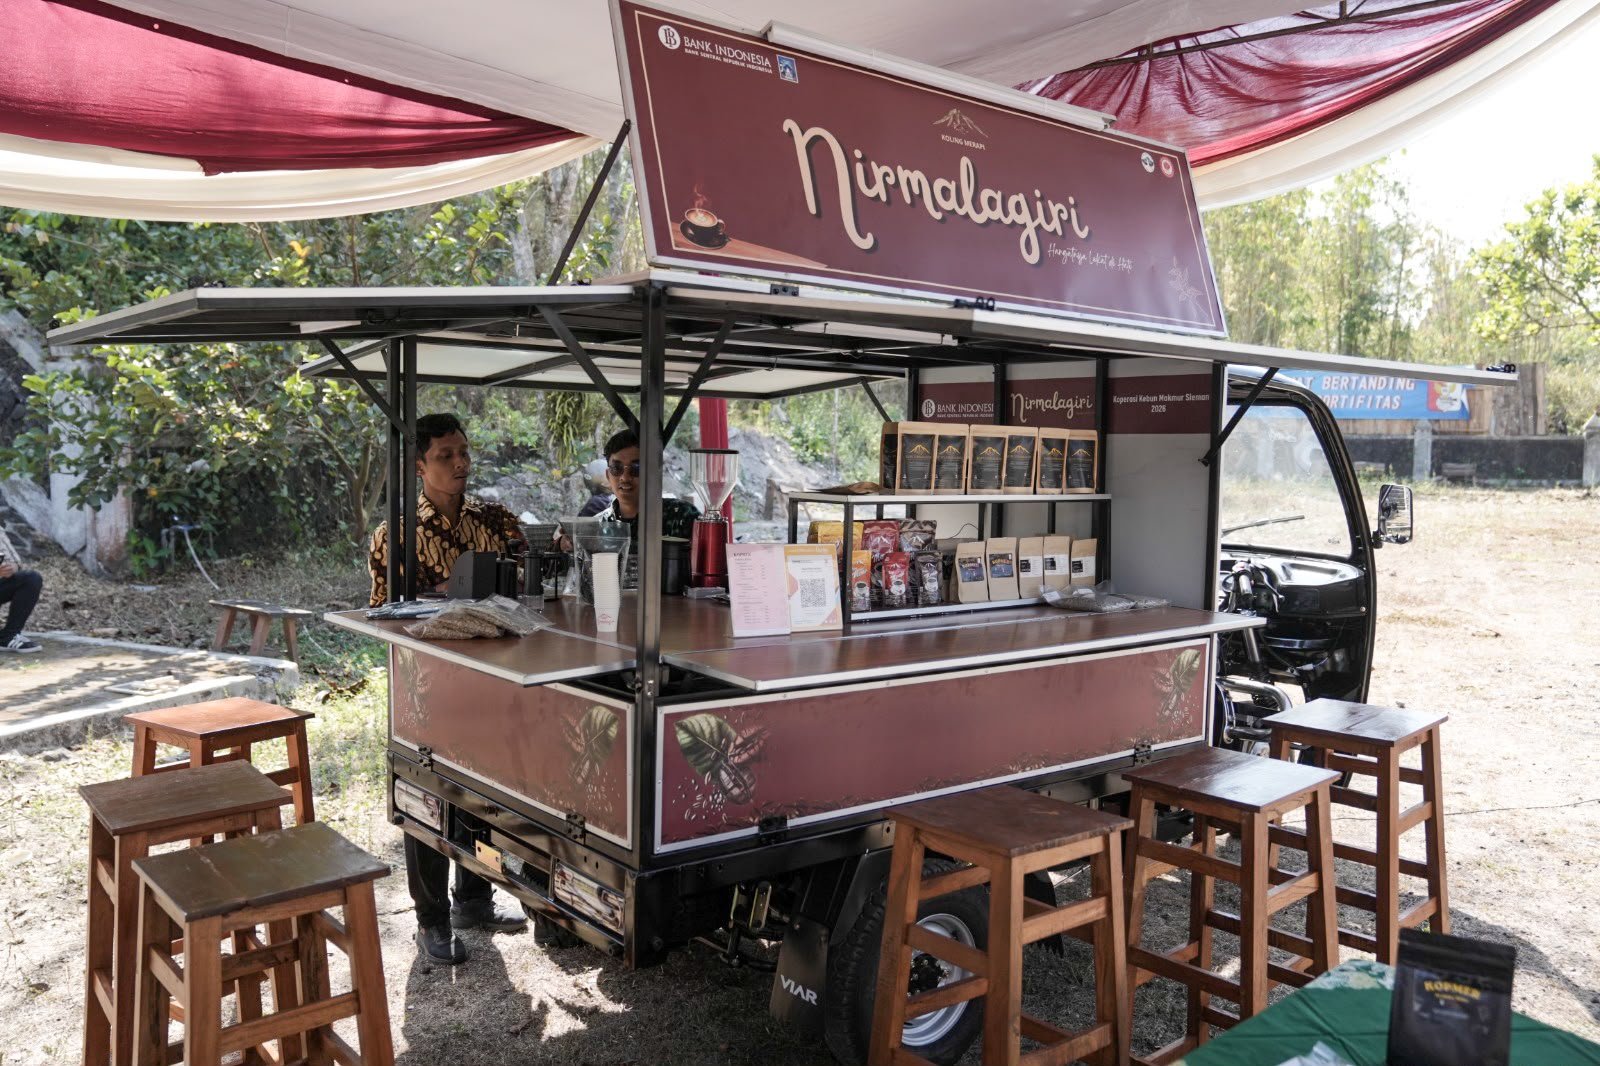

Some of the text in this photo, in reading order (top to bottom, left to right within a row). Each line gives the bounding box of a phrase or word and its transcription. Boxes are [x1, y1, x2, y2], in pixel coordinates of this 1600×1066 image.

[684, 36, 772, 67] BANK INDONESIA
[783, 119, 1089, 264] Nirmalagiri
[1113, 393, 1210, 404] Koperasi Kebun Makmur Sleman
[1322, 375, 1415, 391] BERTANDING
[937, 404, 956, 413] BANK
[1010, 391, 1093, 423] Nirmalagiri
[780, 974, 817, 1006] VIAR
